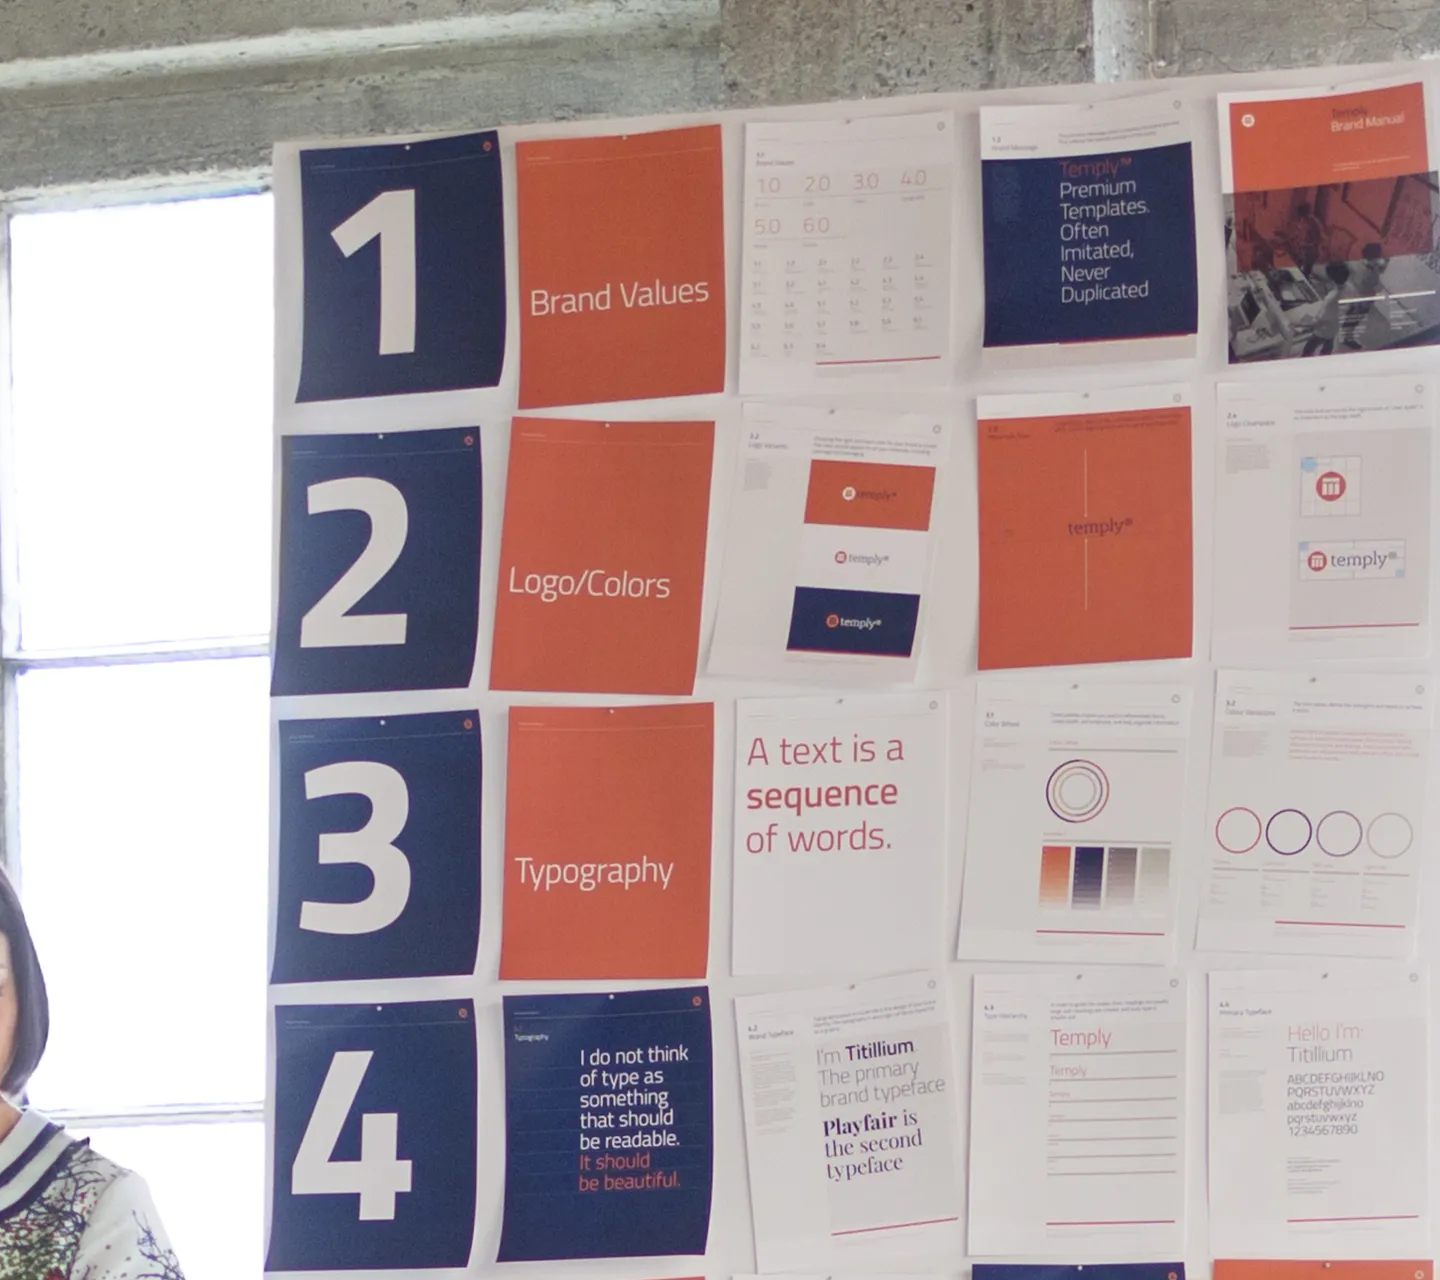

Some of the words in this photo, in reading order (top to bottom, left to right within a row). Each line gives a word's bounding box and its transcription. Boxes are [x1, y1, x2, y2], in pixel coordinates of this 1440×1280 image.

[1331, 118, 1363, 132] Brand
[1365, 112, 1405, 128] Manual
[1060, 179, 1136, 199] Premium
[1060, 200, 1150, 221] Templates.
[1060, 222, 1109, 241] Often
[1061, 239, 1134, 262] Imitated,
[331, 189, 415, 355] 1
[1061, 266, 1111, 282] Never
[530, 283, 611, 317] Brand
[619, 278, 710, 308] Values
[1061, 280, 1149, 305] Duplicated
[299, 476, 409, 648] 2
[509, 566, 671, 602] Logo/Colors
[747, 737, 769, 765] A
[780, 736, 842, 765] text
[853, 733, 876, 763] is
[886, 738, 904, 761] a
[747, 783, 898, 816] sequence
[746, 823, 778, 853] of
[787, 820, 891, 852] words.
[299, 761, 412, 935] 3
[514, 855, 675, 892] Typography
[1050, 1027, 1112, 1049] Temply
[1287, 1023, 1331, 1042] Hello
[580, 1050, 585, 1066] I
[589, 1048, 610, 1066] do
[615, 1048, 644, 1065] not
[648, 1044, 689, 1063] think
[816, 1048, 842, 1066] I'm
[1286, 1045, 1354, 1064] Titillium
[580, 1069, 598, 1087] of
[601, 1071, 639, 1090] type
[643, 1070, 664, 1084] as
[818, 1069, 851, 1087] The
[854, 1061, 920, 1087] primary
[1049, 1064, 1088, 1077] Temply
[580, 1089, 669, 1110] something
[820, 1086, 869, 1108] brand
[873, 1077, 946, 1104] typeface
[580, 1112, 614, 1129] that
[618, 1108, 674, 1128] should
[823, 1111, 898, 1138] Playfair
[903, 1109, 918, 1127] is
[291, 1051, 412, 1221] 4
[580, 1133, 600, 1150] be
[605, 1130, 680, 1149] readable.
[1288, 1124, 1359, 1138] 1234567890
[825, 1139, 854, 1158] the
[859, 1128, 923, 1154] second
[579, 1154, 591, 1171] It
[595, 1152, 651, 1171] should
[826, 1155, 904, 1182] typeface
[579, 1175, 599, 1192] be
[604, 1171, 681, 1191] beautiful.
